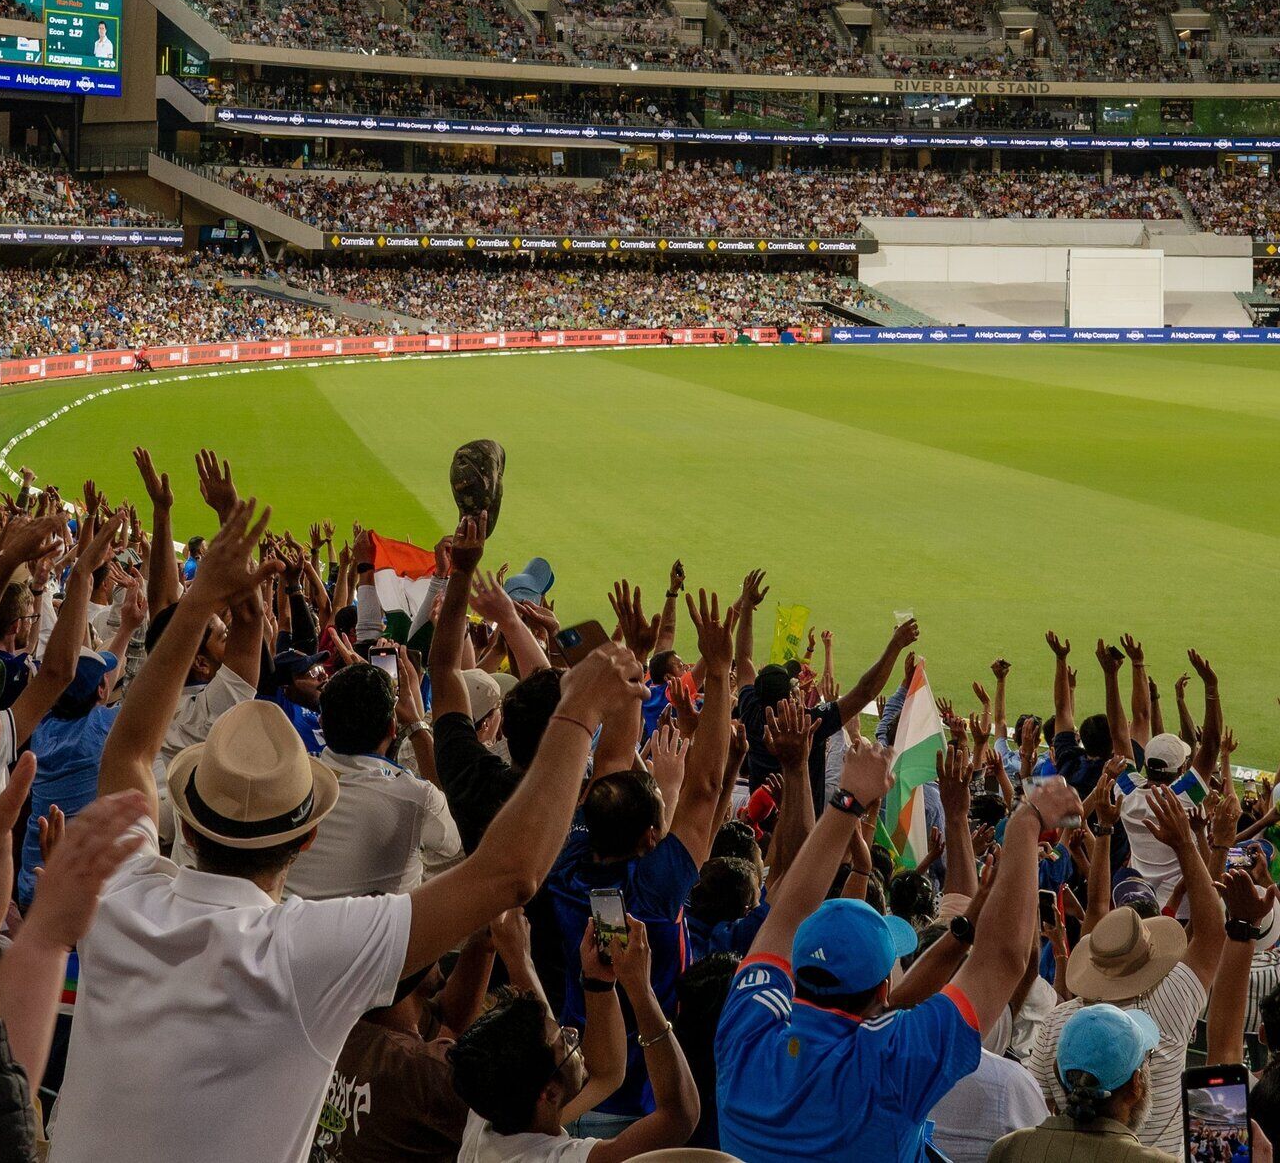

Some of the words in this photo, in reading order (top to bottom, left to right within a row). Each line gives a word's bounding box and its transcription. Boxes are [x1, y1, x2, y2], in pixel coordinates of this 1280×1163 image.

[49, 17, 67, 25] Overs
[26, 53, 34, 61] 21
[16, 74, 22, 82] A
[23, 74, 39, 85] Help
[39, 76, 71, 88] Company
[894, 81, 989, 93] RIVERBANK
[997, 83, 1050, 94] STAND
[340, 237, 374, 245] CommBank
[386, 238, 418, 246] CommBank
[430, 238, 463, 246] CommBank
[476, 239, 509, 247] CommBank
[522, 239, 556, 247] CommBank
[572, 240, 606, 248] CommBank
[620, 240, 655, 248] CommBank
[668, 241, 704, 249] CommBank
[718, 241, 754, 249] CommBank
[767, 242, 804, 250] CommBank
[819, 242, 856, 250] CommBank
